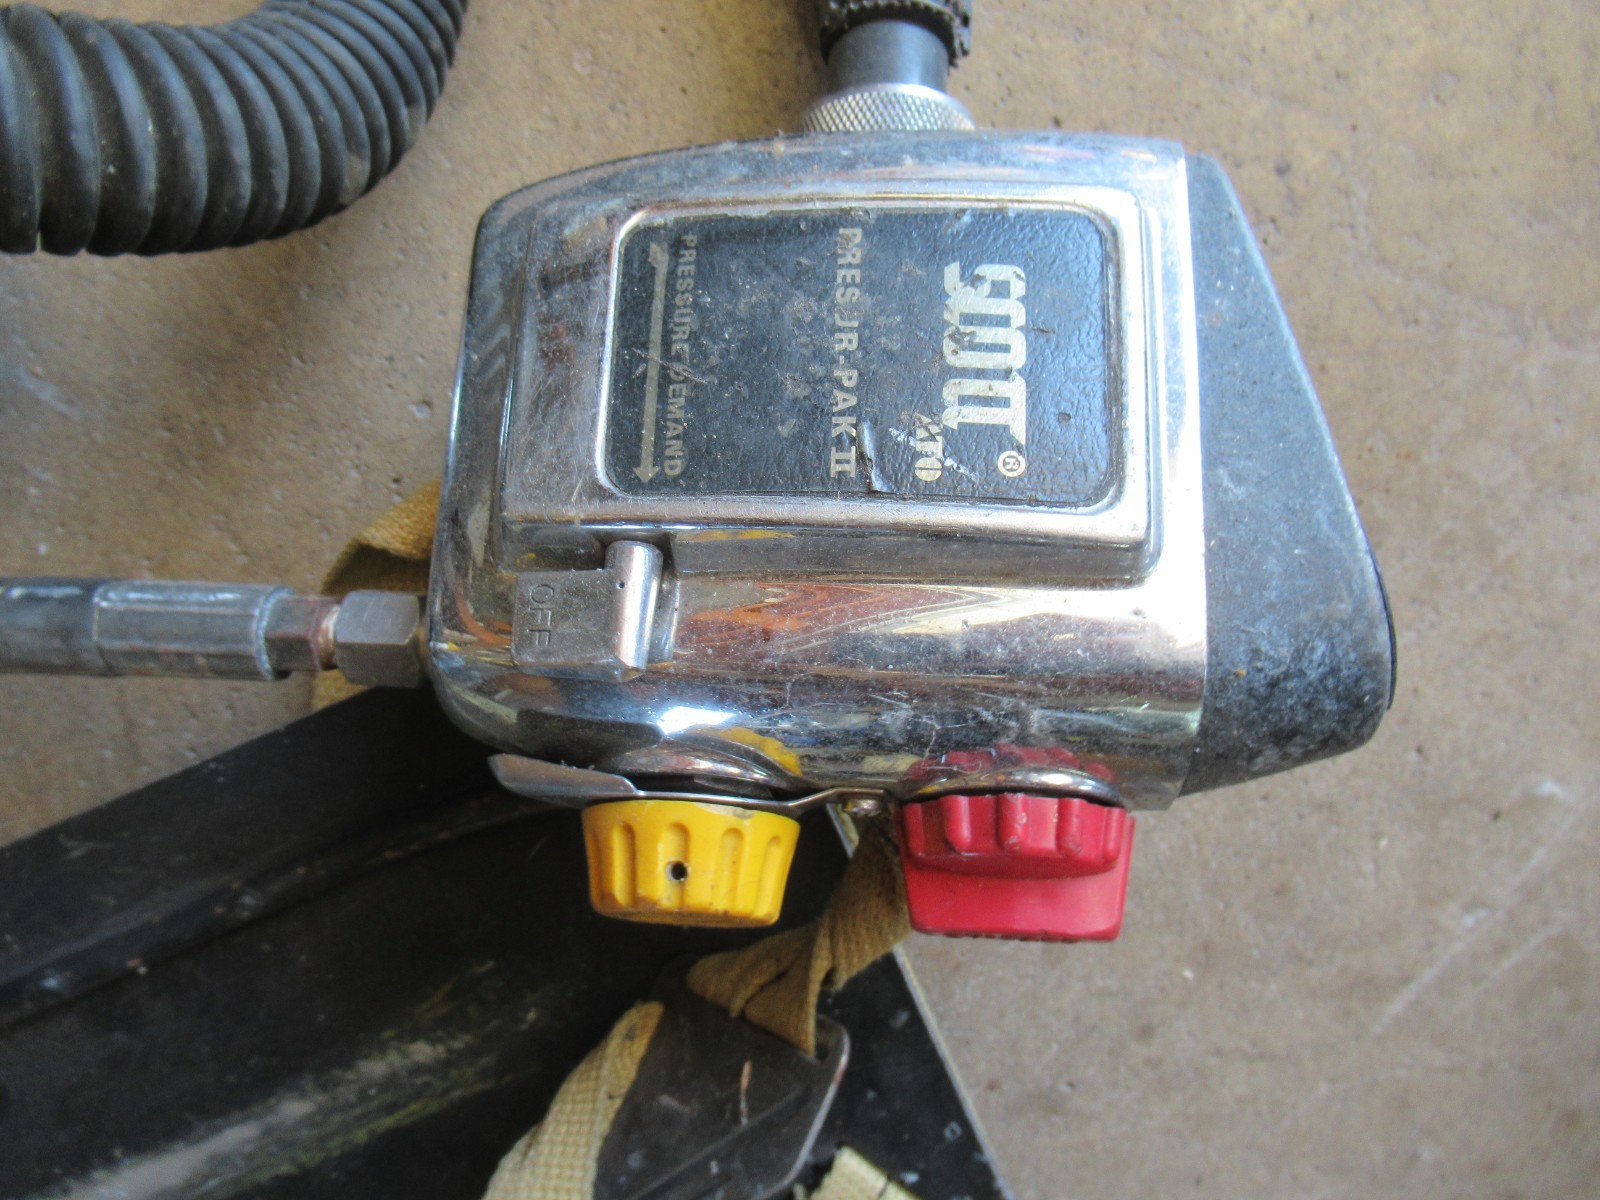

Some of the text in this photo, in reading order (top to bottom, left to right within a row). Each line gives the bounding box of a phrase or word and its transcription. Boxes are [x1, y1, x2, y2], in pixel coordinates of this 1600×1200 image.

[664, 233, 698, 478] PRESSURE DEMAND
[527, 583, 555, 646] OFF
